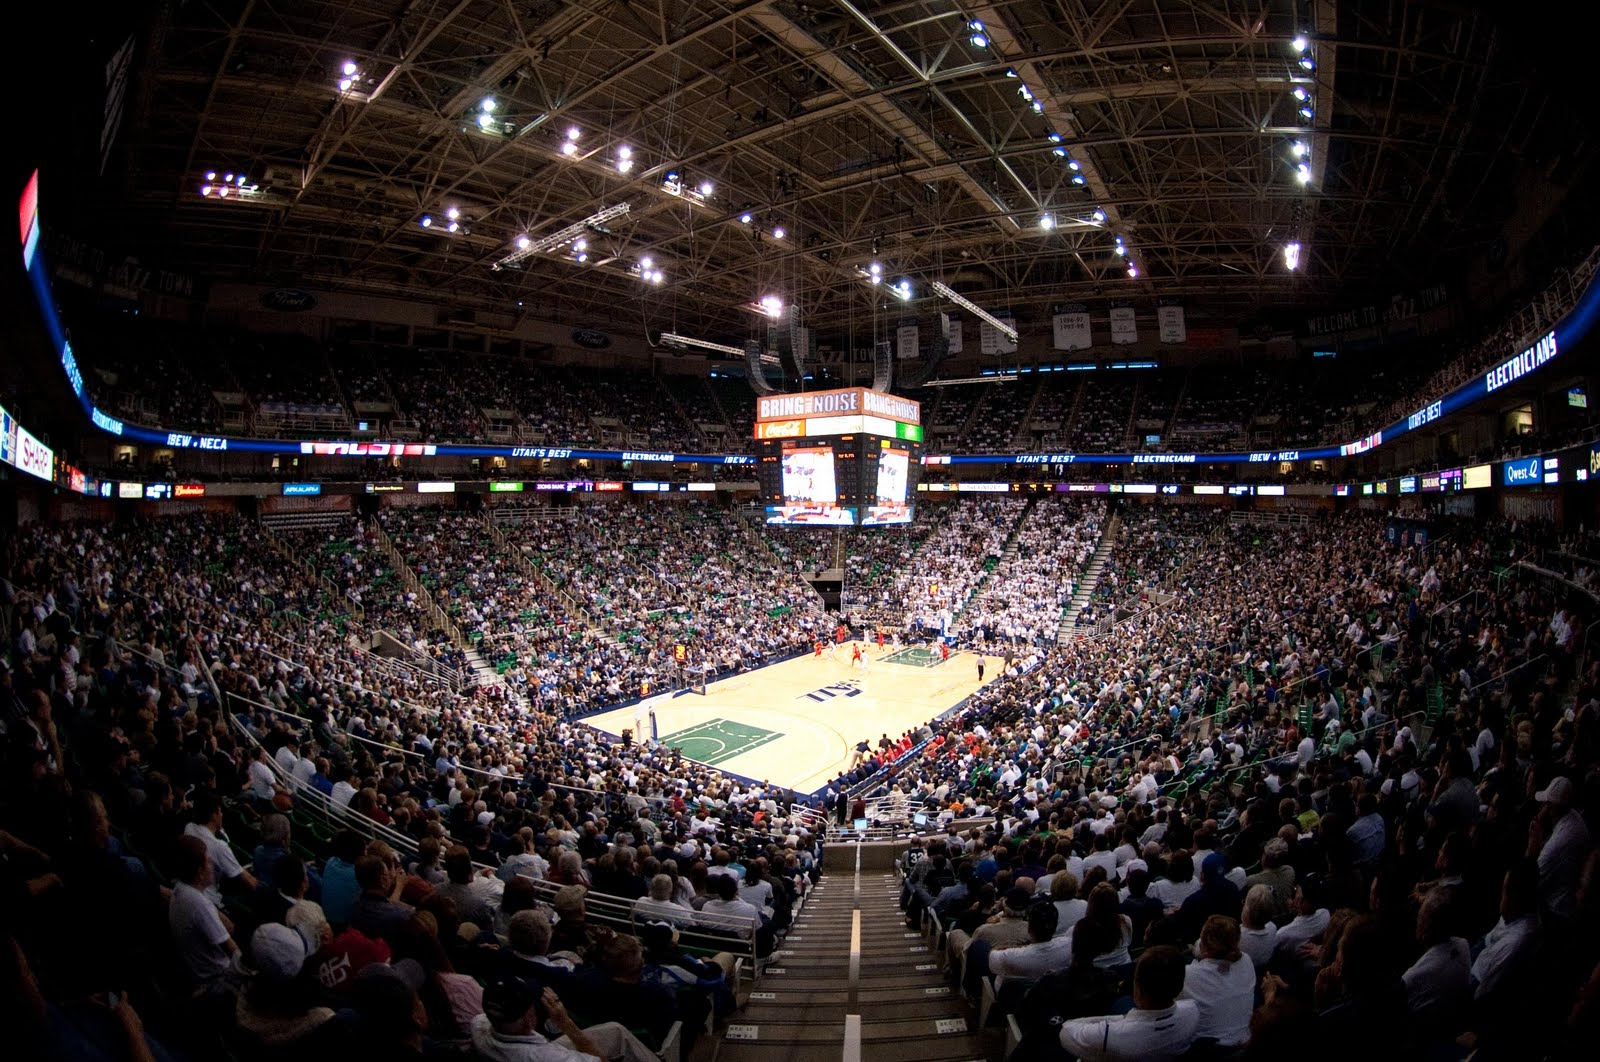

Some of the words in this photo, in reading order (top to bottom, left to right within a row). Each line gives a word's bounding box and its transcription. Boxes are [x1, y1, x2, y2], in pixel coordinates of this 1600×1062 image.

[1487, 331, 1557, 392] ELECTRICIANS
[761, 396, 804, 418] BRING
[813, 391, 858, 414] NOISE
[863, 391, 891, 416] BRING
[896, 400, 918, 421] NOISE
[1427, 399, 1442, 421] BEST
[167, 433, 192, 447] IBEW
[199, 437, 227, 450] NECA
[512, 448, 546, 458] UTAH'S
[548, 450, 573, 459] BEST
[622, 453, 674, 462] ELECTRICIANS
[724, 456, 748, 464] IBEW
[1016, 455, 1048, 463] UTAH'S
[1050, 455, 1075, 463] BEST
[1133, 455, 1196, 463] ELECTRICIANS
[1249, 453, 1271, 462] IBEW
[1278, 451, 1299, 461] NECA
[1508, 465, 1528, 482] Qwest
